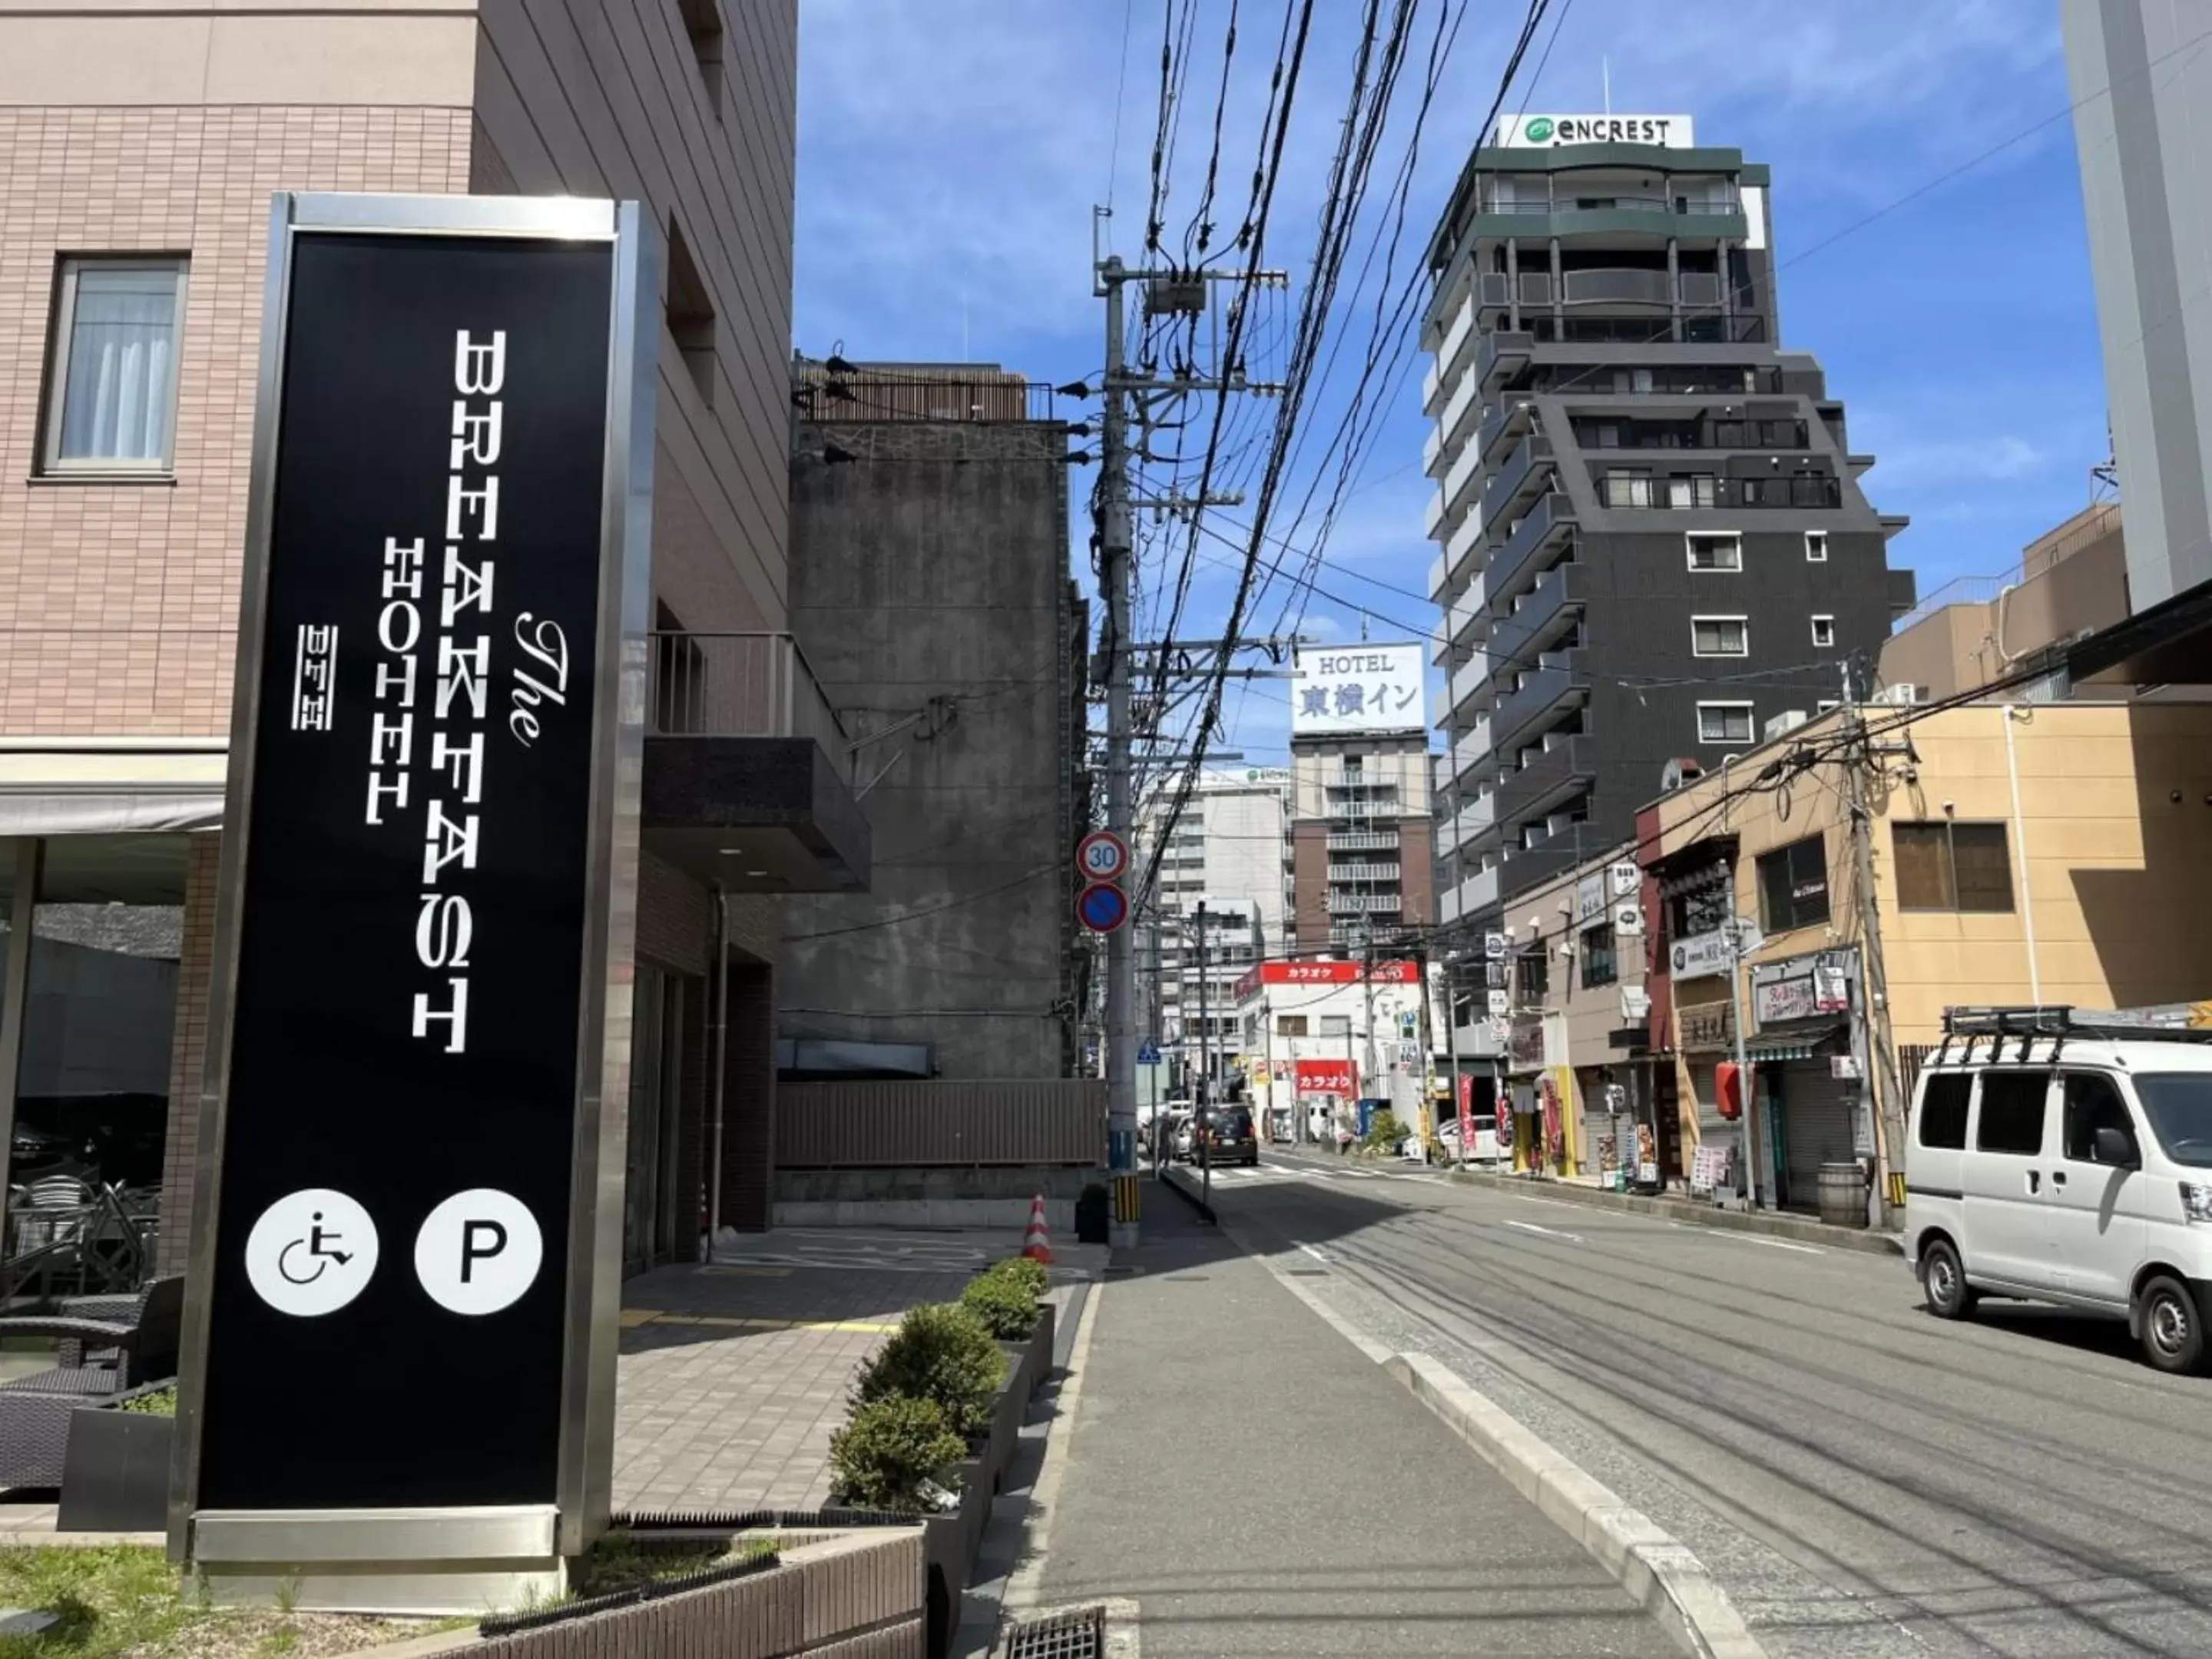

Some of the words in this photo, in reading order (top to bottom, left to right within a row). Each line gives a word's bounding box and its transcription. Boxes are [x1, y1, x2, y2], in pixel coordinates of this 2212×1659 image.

[300, 624, 329, 730] BFH
[366, 537, 425, 824] HOTEL
[412, 329, 507, 1054] BREAKFAST
[509, 611, 569, 747] The
[1319, 654, 1395, 675] HOTEL
[1299, 683, 1419, 718] 東横イン
[1089, 847, 1116, 868] 30
[1287, 967, 1333, 979] カラオケ
[460, 1220, 508, 1283] P
